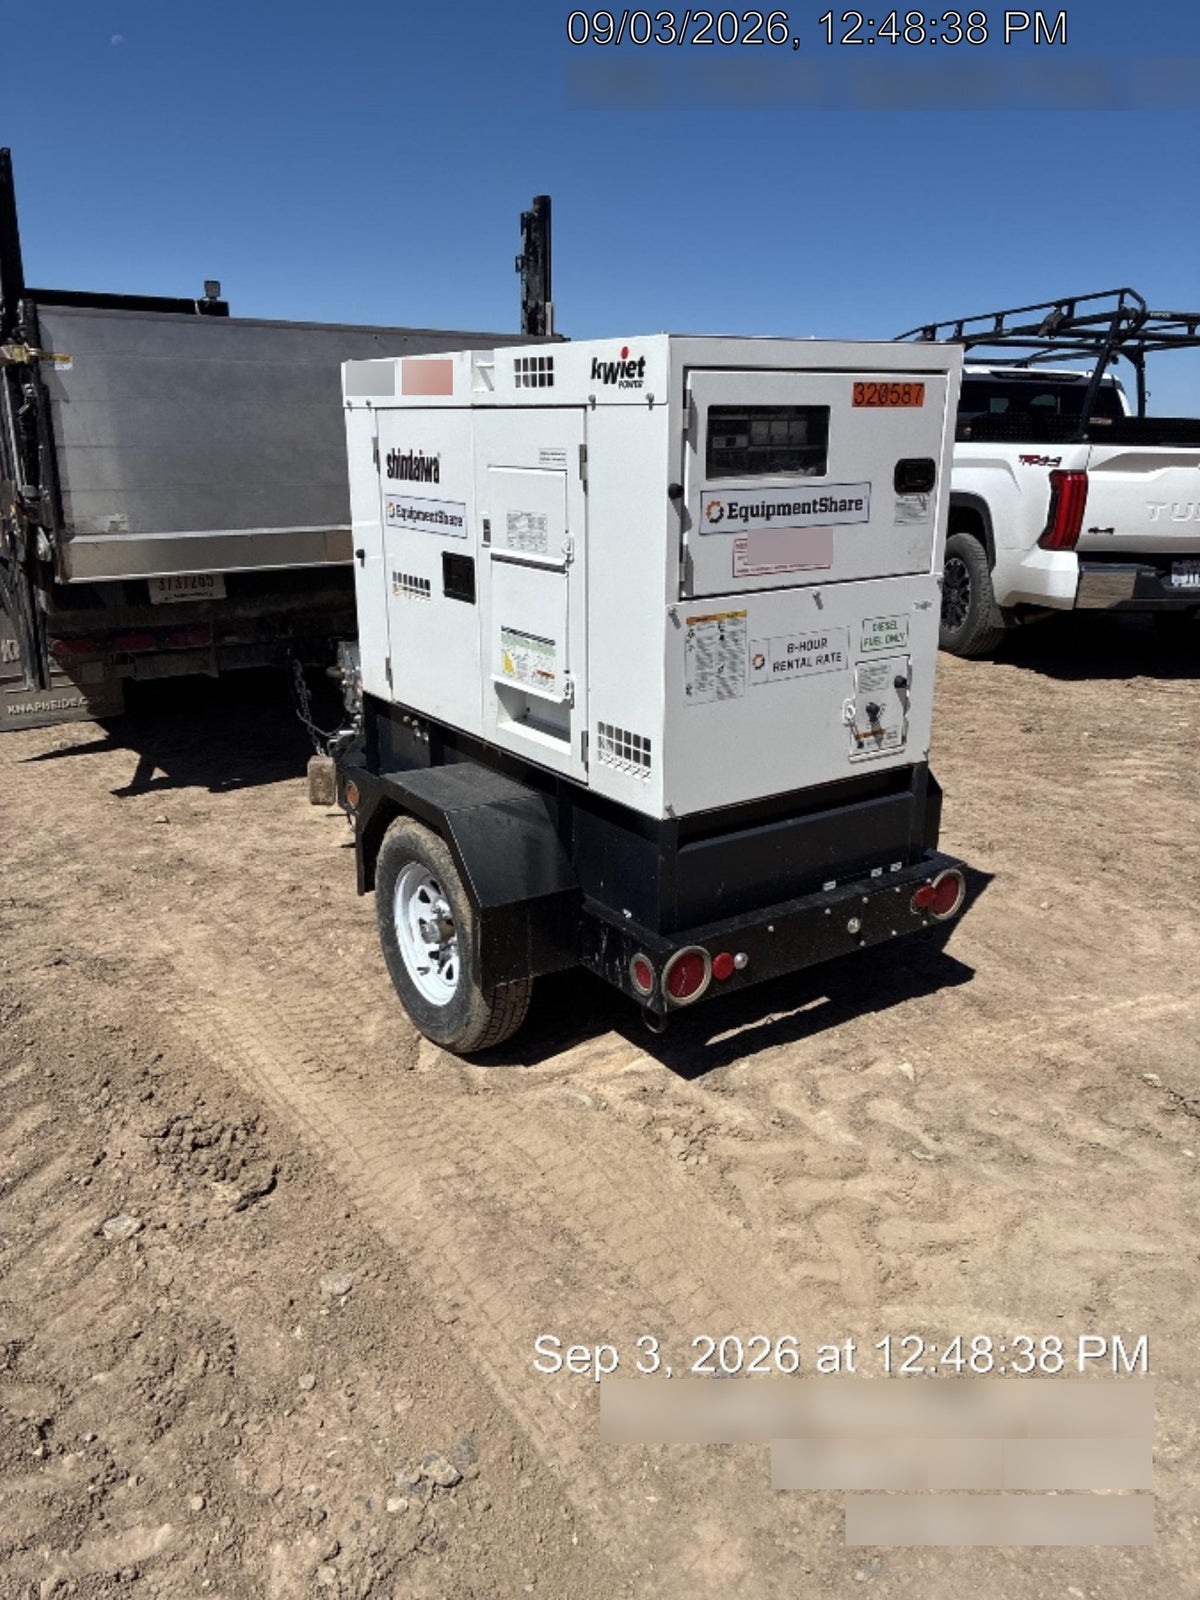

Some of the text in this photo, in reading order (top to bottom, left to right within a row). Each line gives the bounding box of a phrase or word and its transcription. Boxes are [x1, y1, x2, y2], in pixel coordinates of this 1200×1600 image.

[591, 346, 646, 385] kwiet
[854, 383, 923, 405] 320587
[387, 447, 440, 484] shindaiwa
[395, 504, 464, 527] EquipmentShare
[726, 497, 864, 523] EquipmentShare
[872, 621, 898, 632] DIESEL
[787, 637, 828, 653] 8-HOUR
[863, 632, 905, 647] FUEL ONLY
[773, 651, 843, 673] RENTAL RATE
